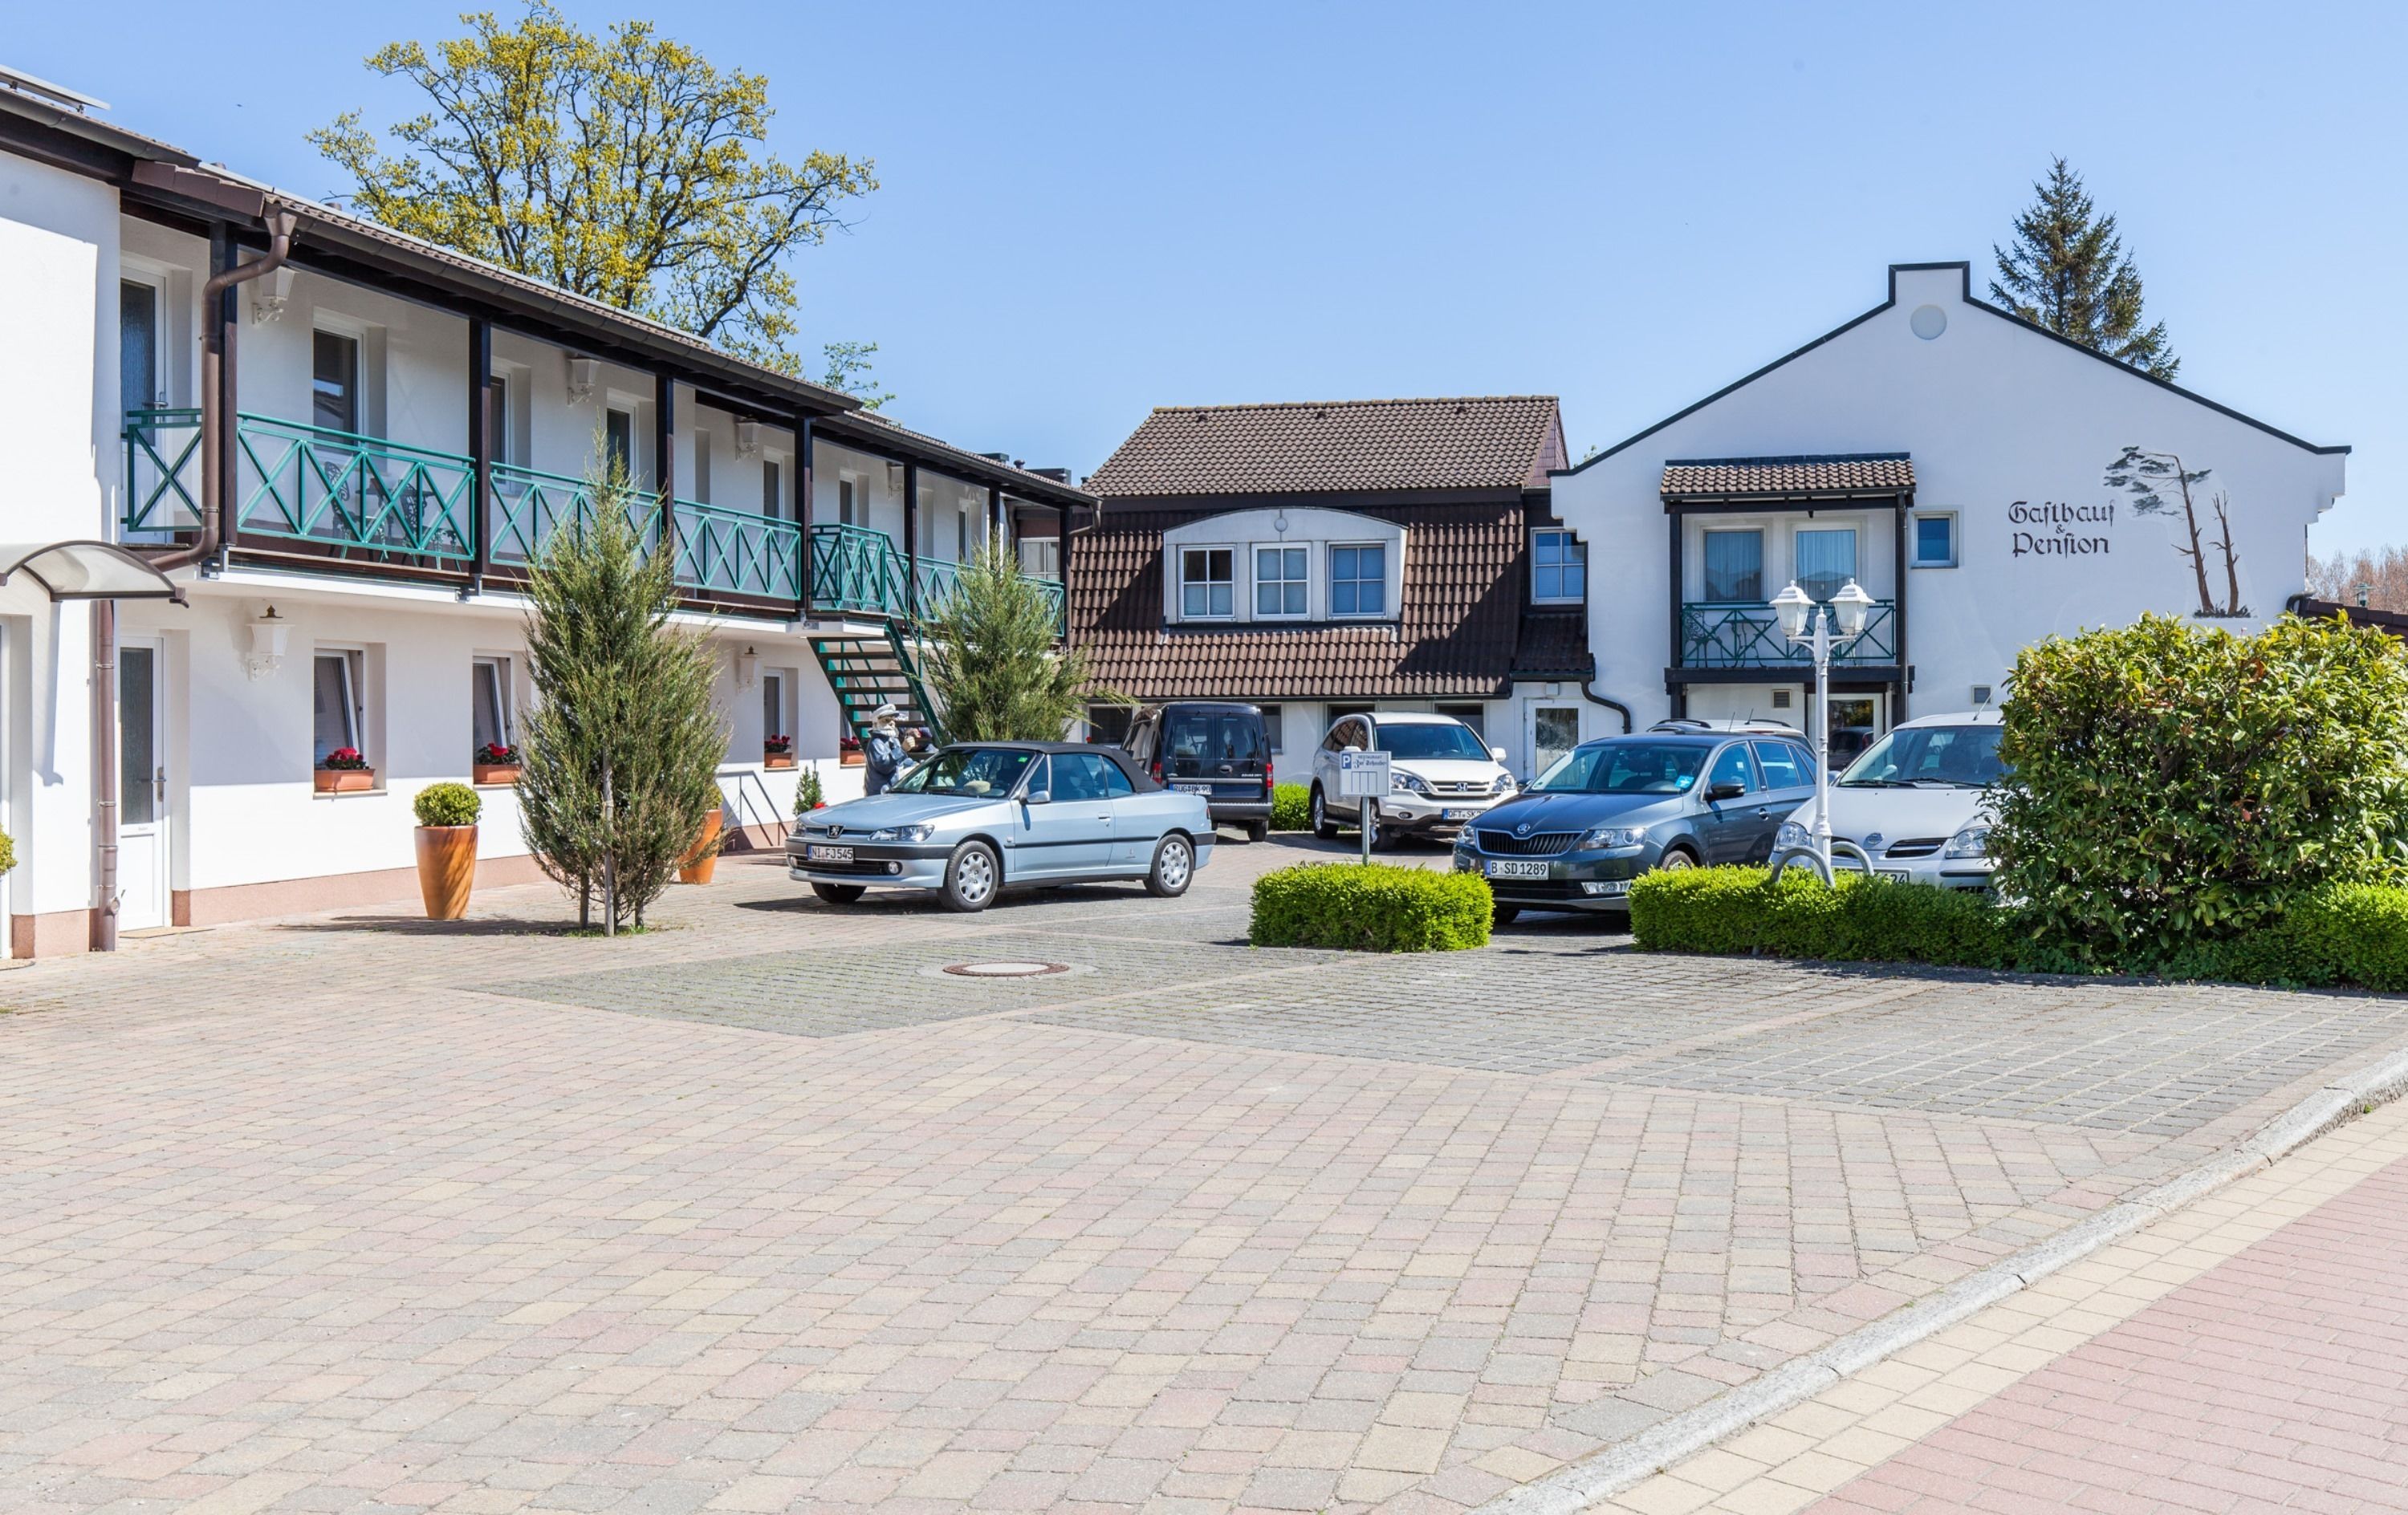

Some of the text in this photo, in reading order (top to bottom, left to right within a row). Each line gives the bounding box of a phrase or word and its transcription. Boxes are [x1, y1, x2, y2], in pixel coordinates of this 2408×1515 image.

[2008, 499, 2116, 527] Gasthaus
[2055, 524, 2066, 534] &
[2012, 532, 2111, 559] Pension
[1343, 755, 1350, 767] P
[1519, 863, 1547, 875] 1289
